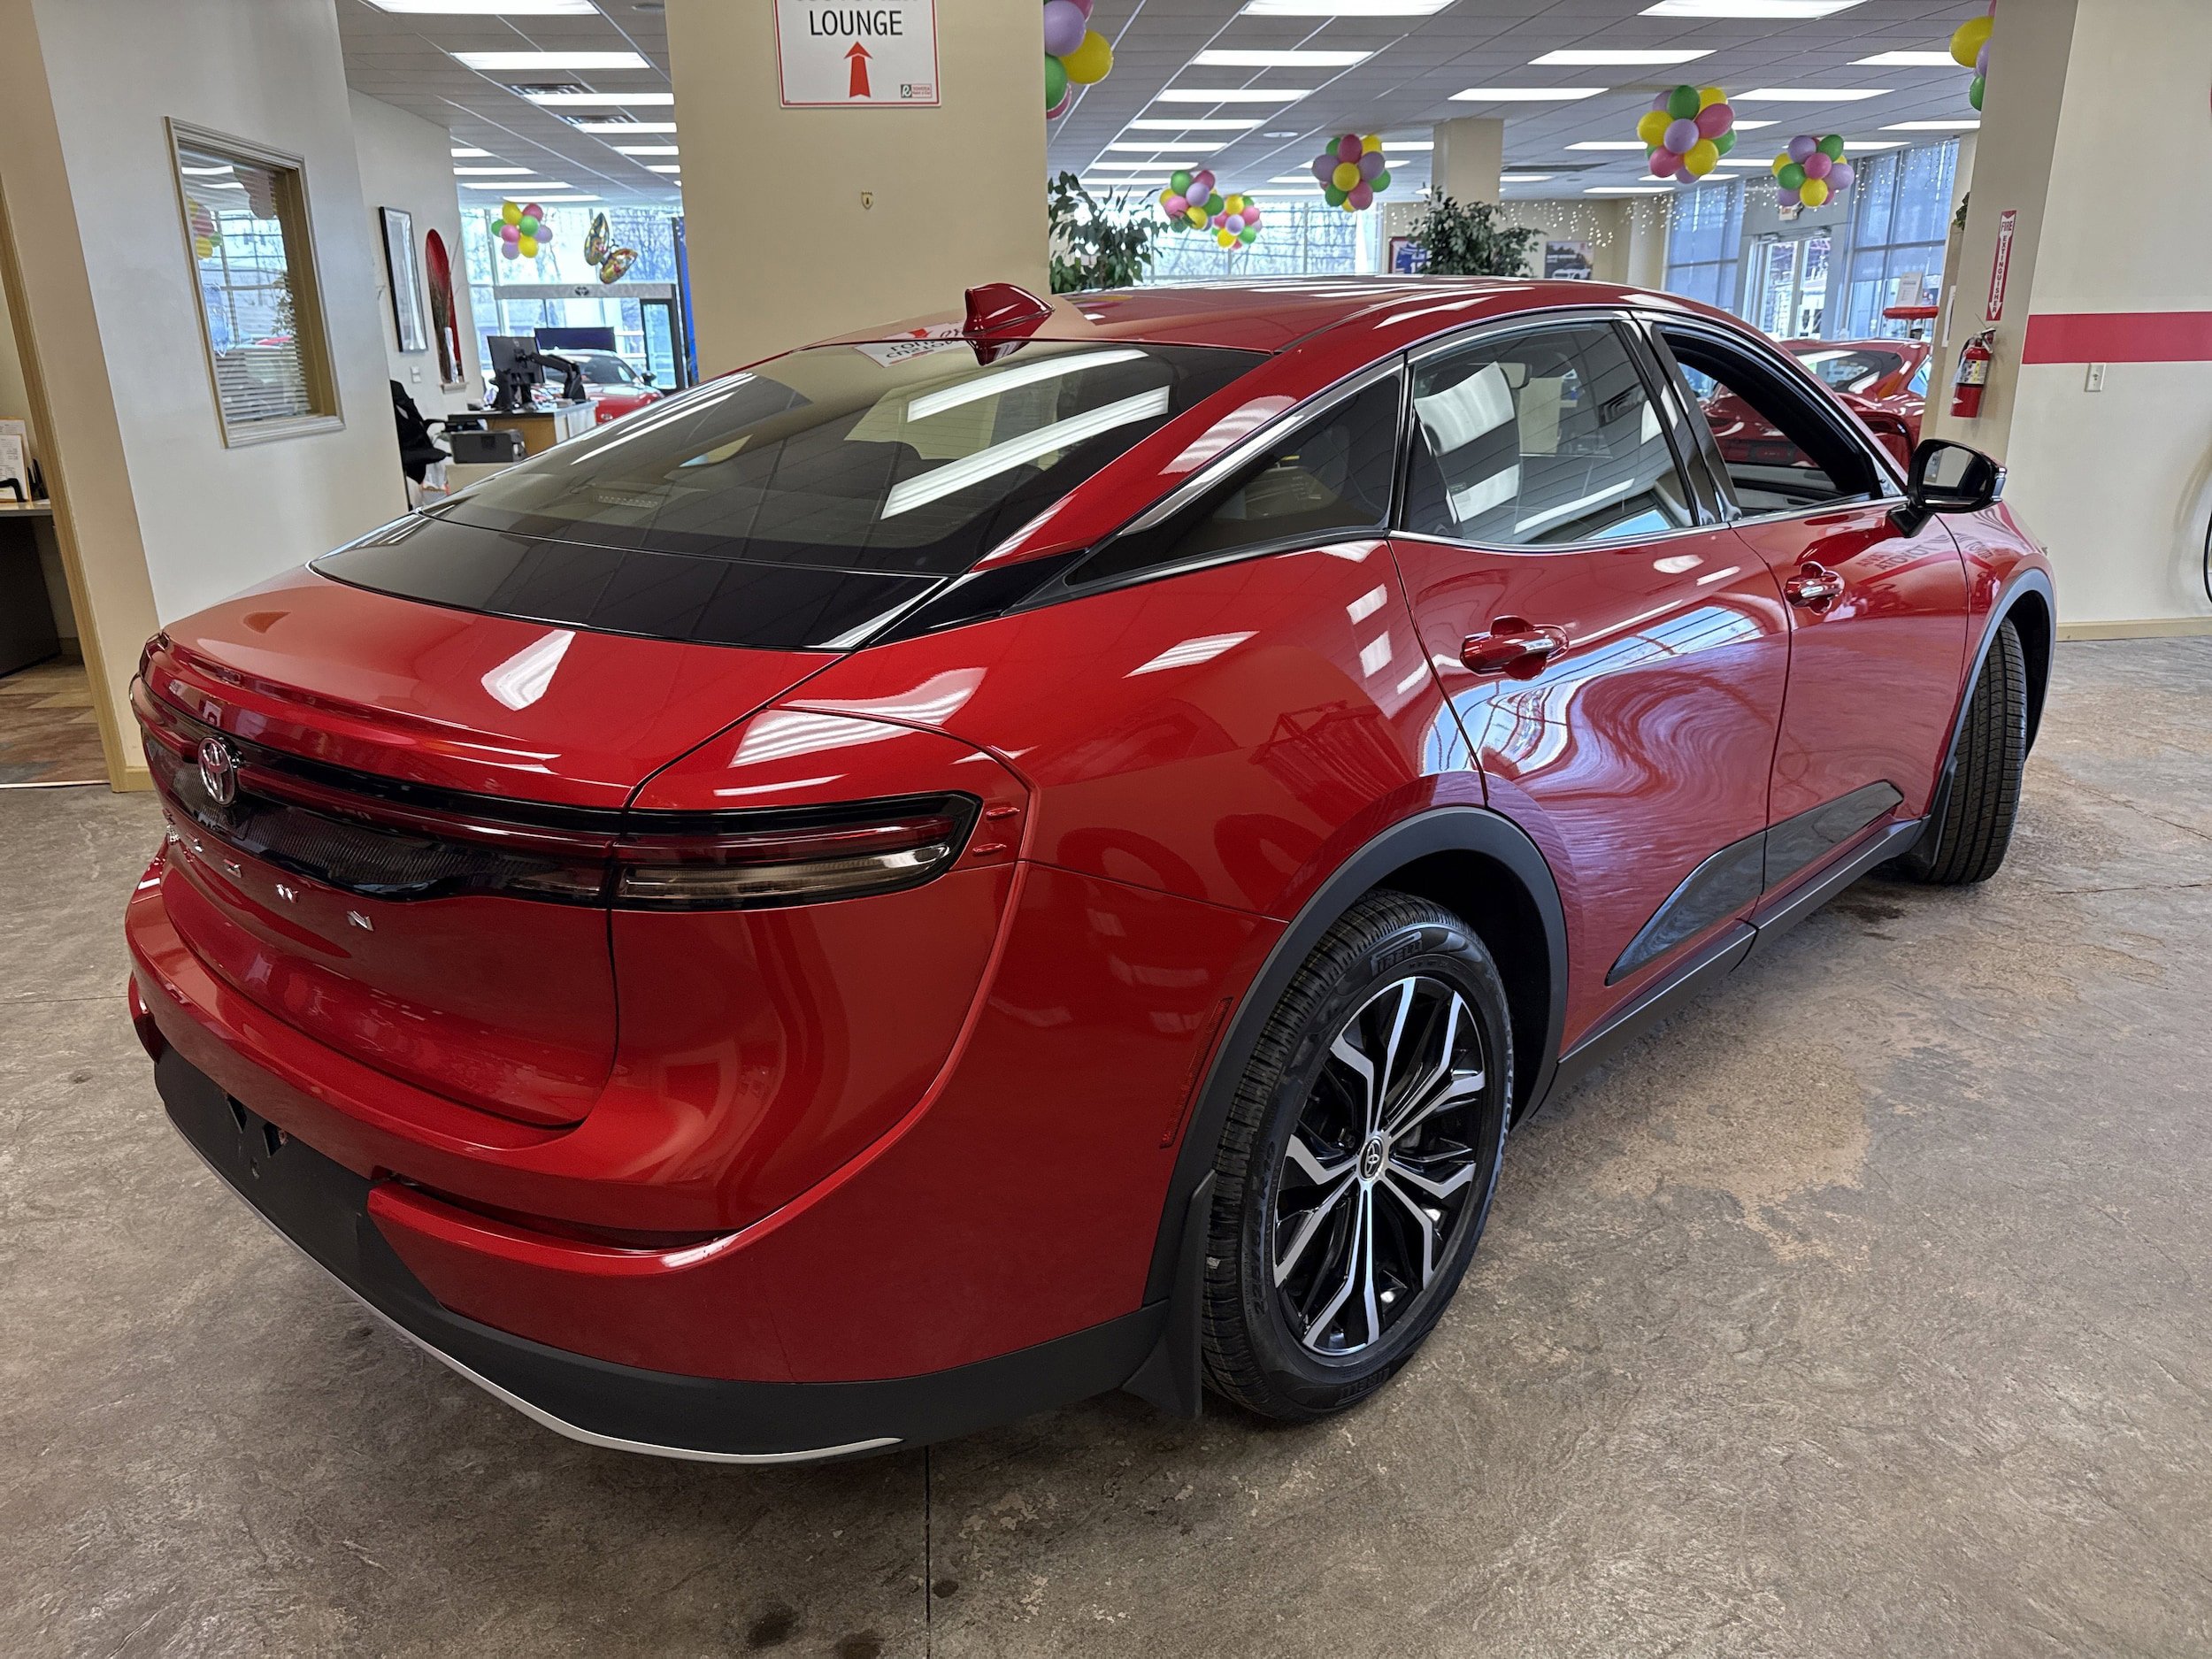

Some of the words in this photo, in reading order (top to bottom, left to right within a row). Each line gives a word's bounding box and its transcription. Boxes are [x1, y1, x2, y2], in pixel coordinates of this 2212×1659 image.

[810, 10, 903, 36] LOUNGE
[2001, 220, 2014, 232] FIRE
[1992, 234, 2008, 313] EXTINGUISHER
